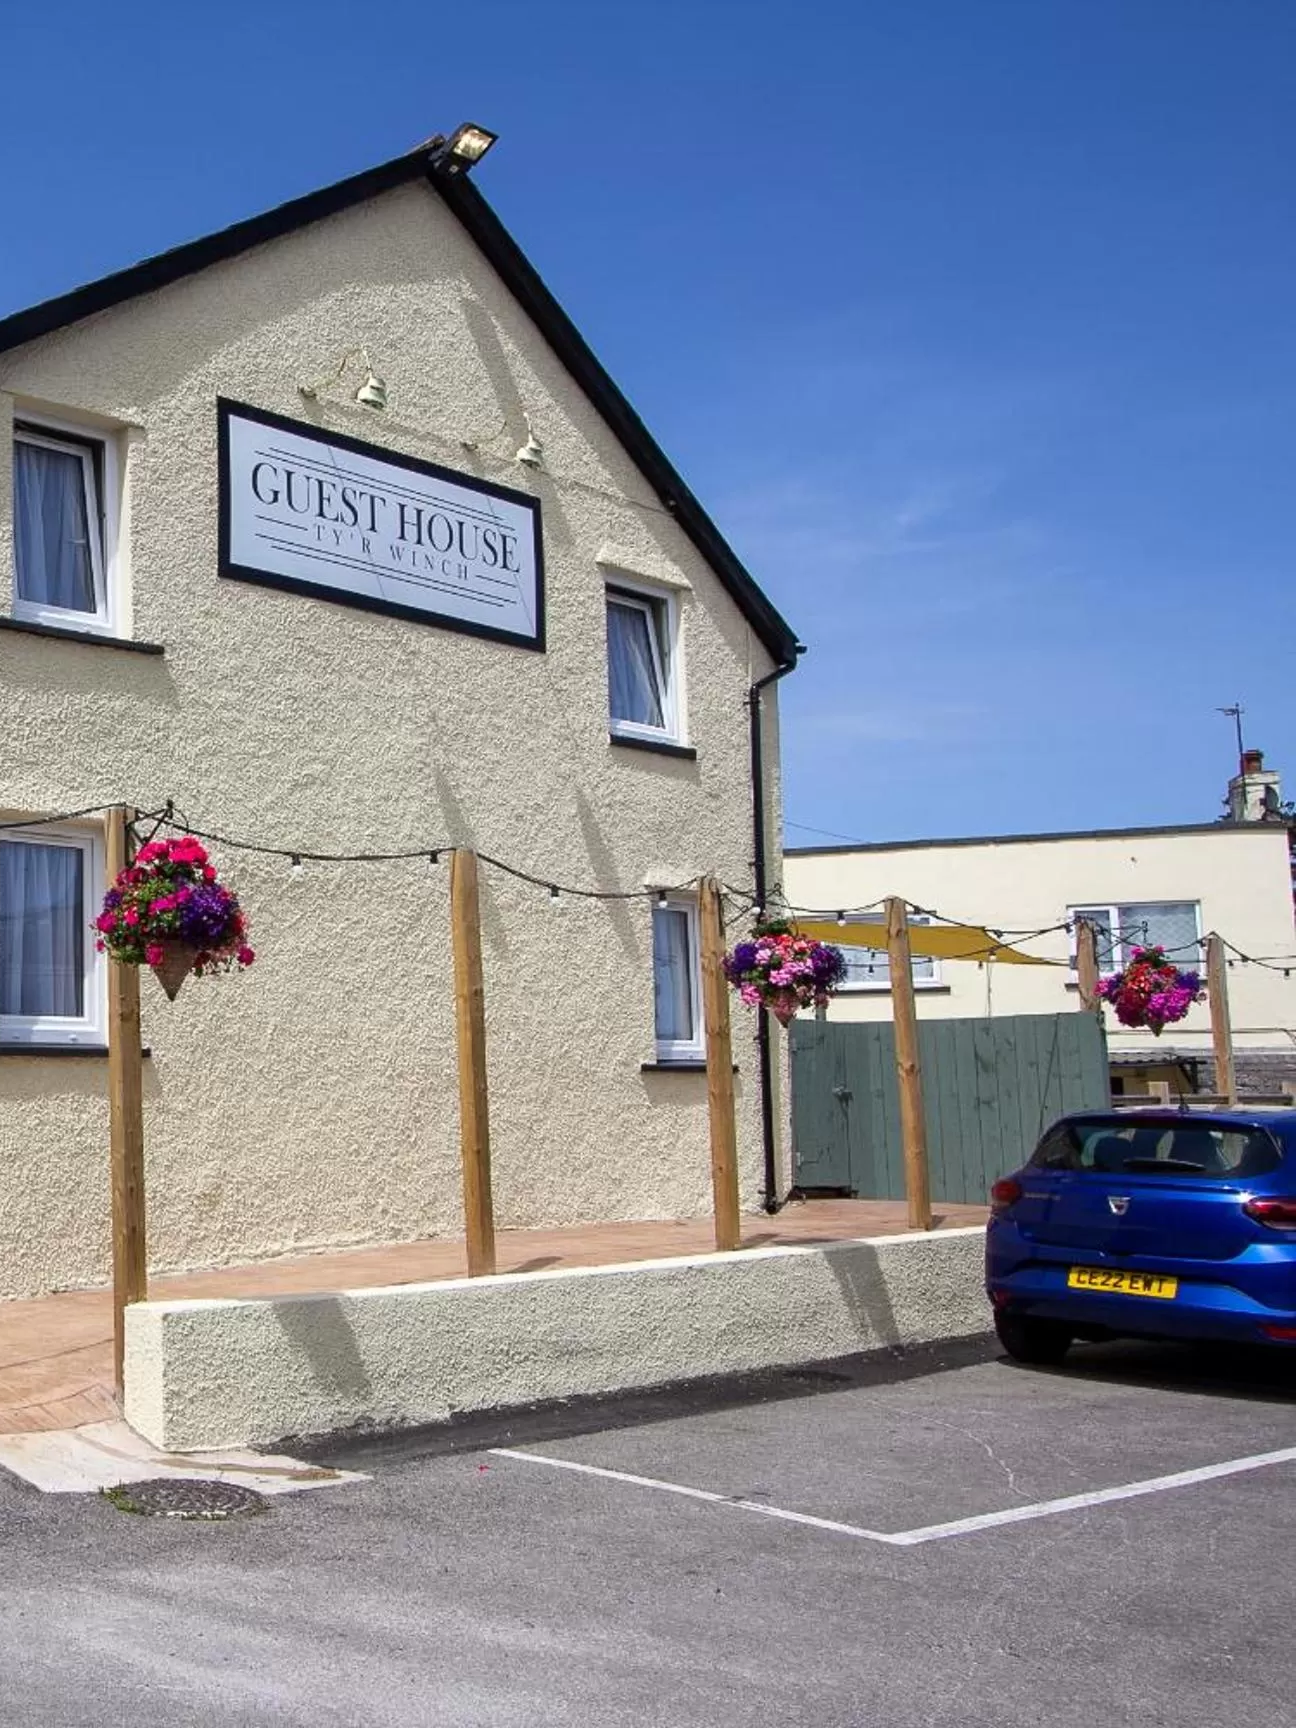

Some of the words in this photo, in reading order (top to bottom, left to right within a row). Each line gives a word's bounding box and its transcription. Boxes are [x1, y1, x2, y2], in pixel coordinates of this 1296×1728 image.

[251, 461, 386, 535] GUEST
[397, 502, 521, 574] HOUSE
[389, 544, 469, 581] WINCH
[1076, 1269, 1124, 1289] CE22
[1128, 1274, 1169, 1294] EWT
